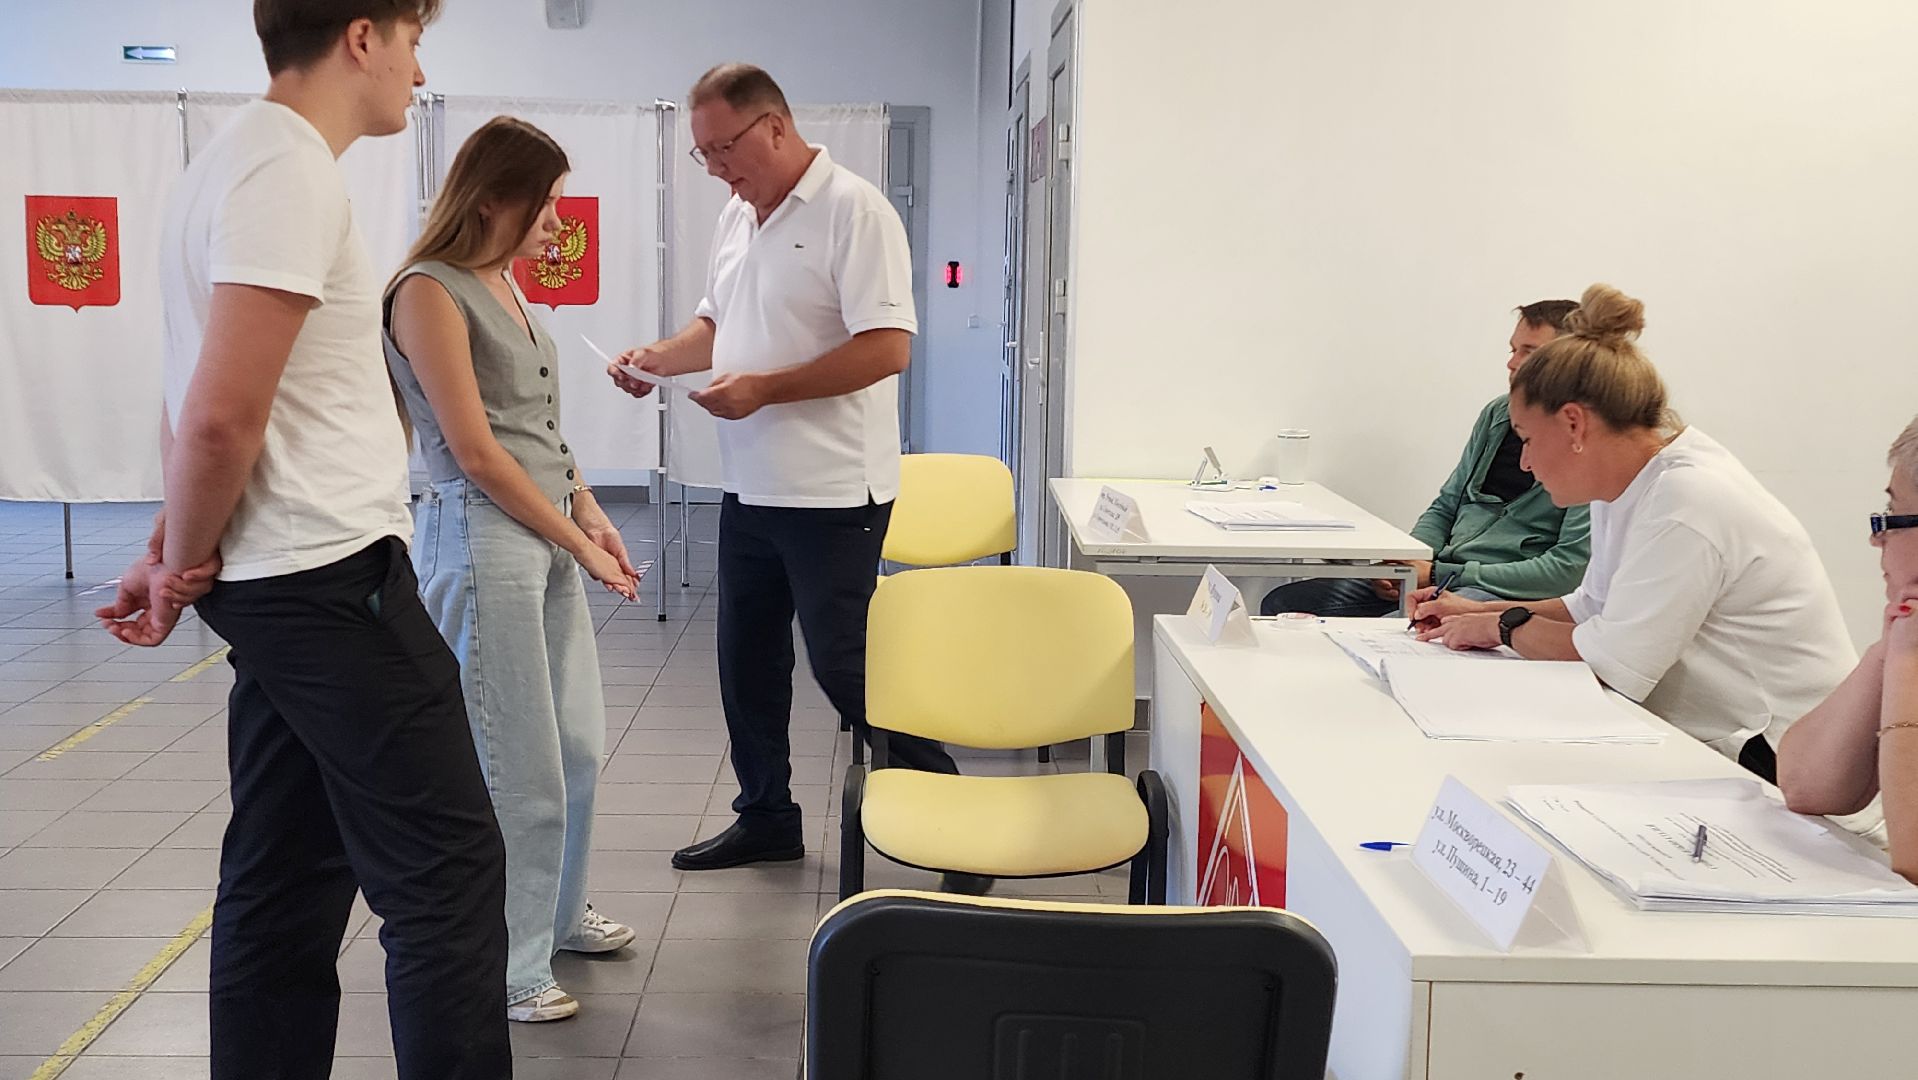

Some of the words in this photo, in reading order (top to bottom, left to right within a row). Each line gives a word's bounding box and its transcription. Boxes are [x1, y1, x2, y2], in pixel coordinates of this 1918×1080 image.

[1480, 876, 1490, 892] 1
[1492, 887, 1508, 906] 19
[1502, 858, 1517, 878] 23
[1522, 875, 1536, 895] 44
